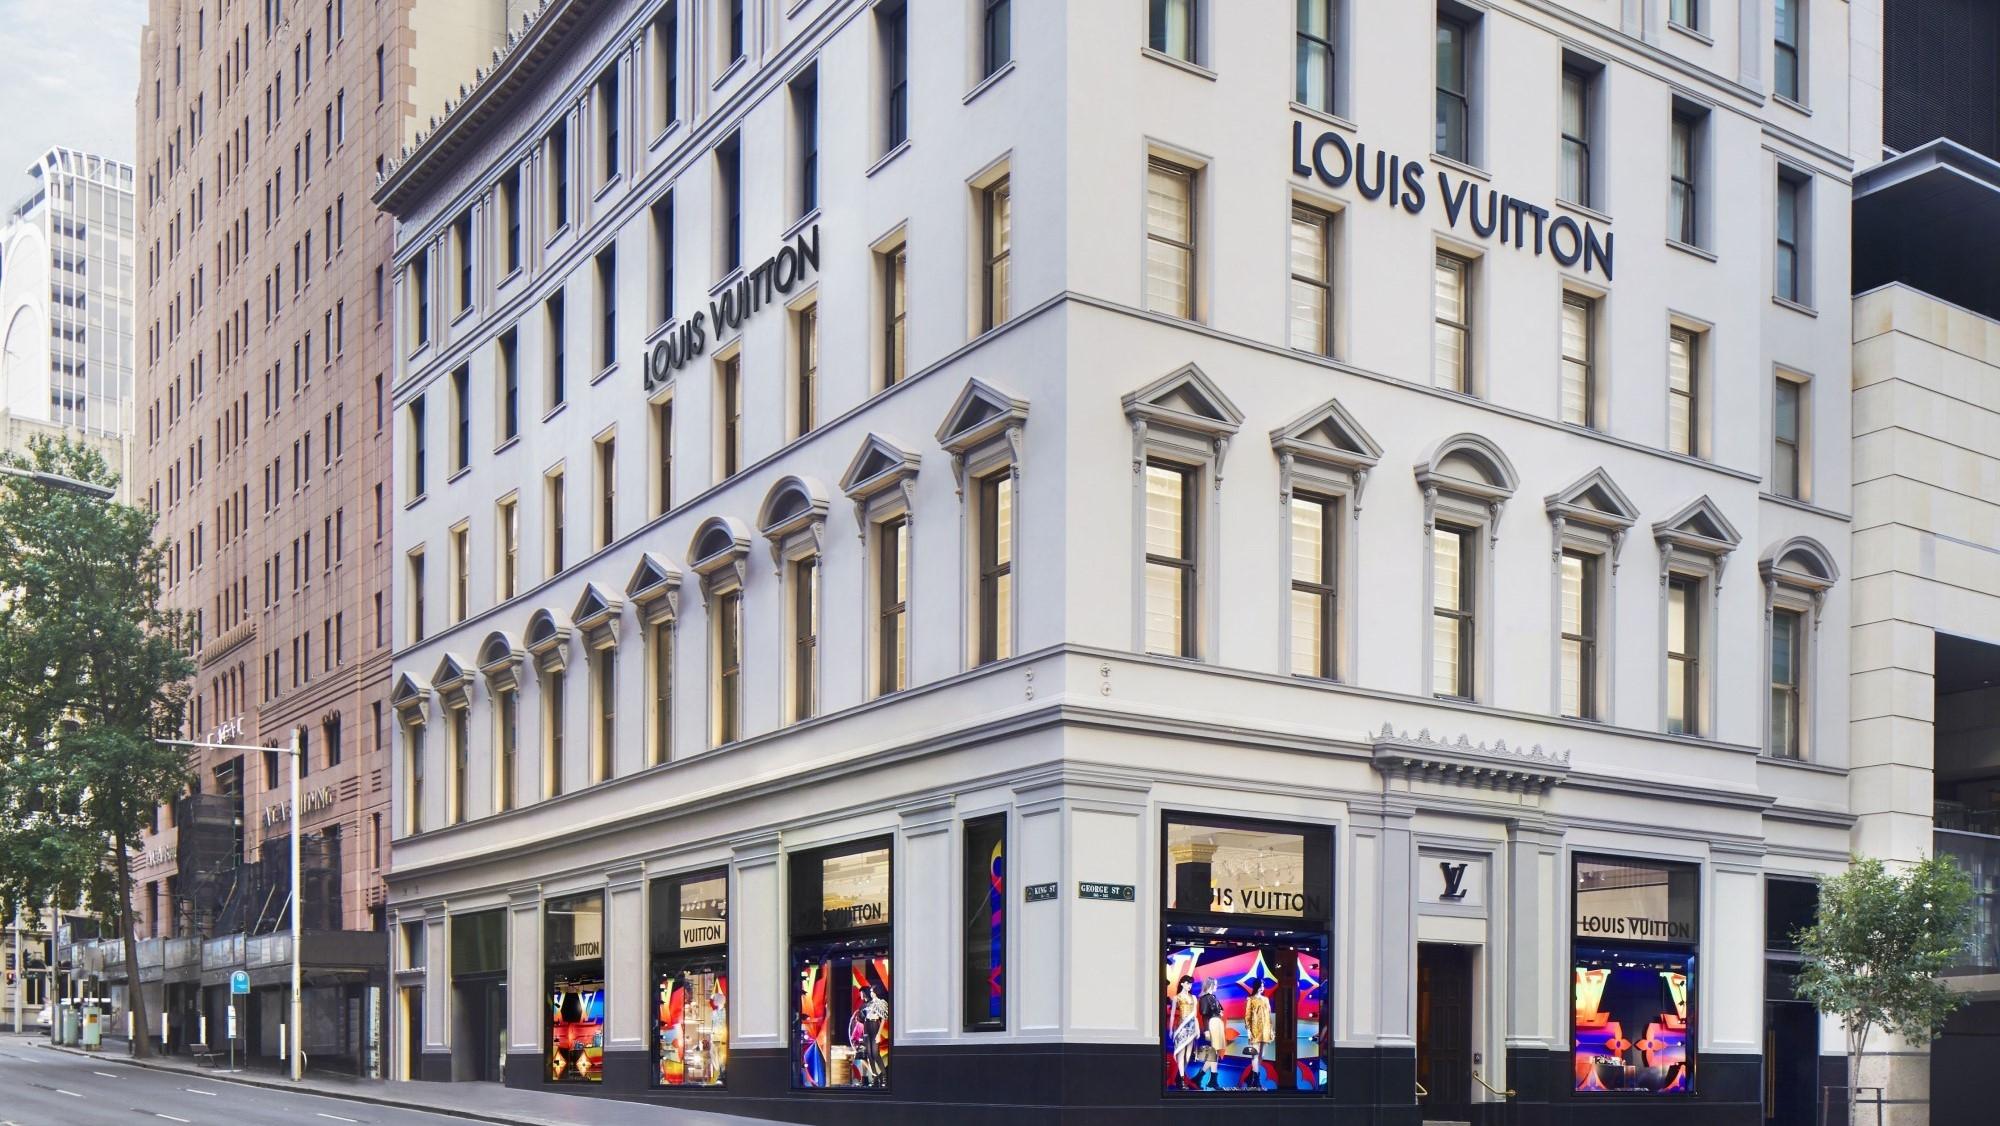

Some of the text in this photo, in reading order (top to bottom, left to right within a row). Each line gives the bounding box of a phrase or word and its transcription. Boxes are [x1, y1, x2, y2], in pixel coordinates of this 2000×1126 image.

[1293, 120, 1614, 282] LOUIS VUITTON
[643, 224, 820, 391] LOUIS VUITTON
[1034, 884, 1056, 895] KING ST
[1080, 884, 1120, 895] GEORGE ST
[1240, 889, 1320, 912] VUITTON
[683, 924, 721, 943] VUITTON
[1582, 915, 1690, 938] LOUIS VUITTON
